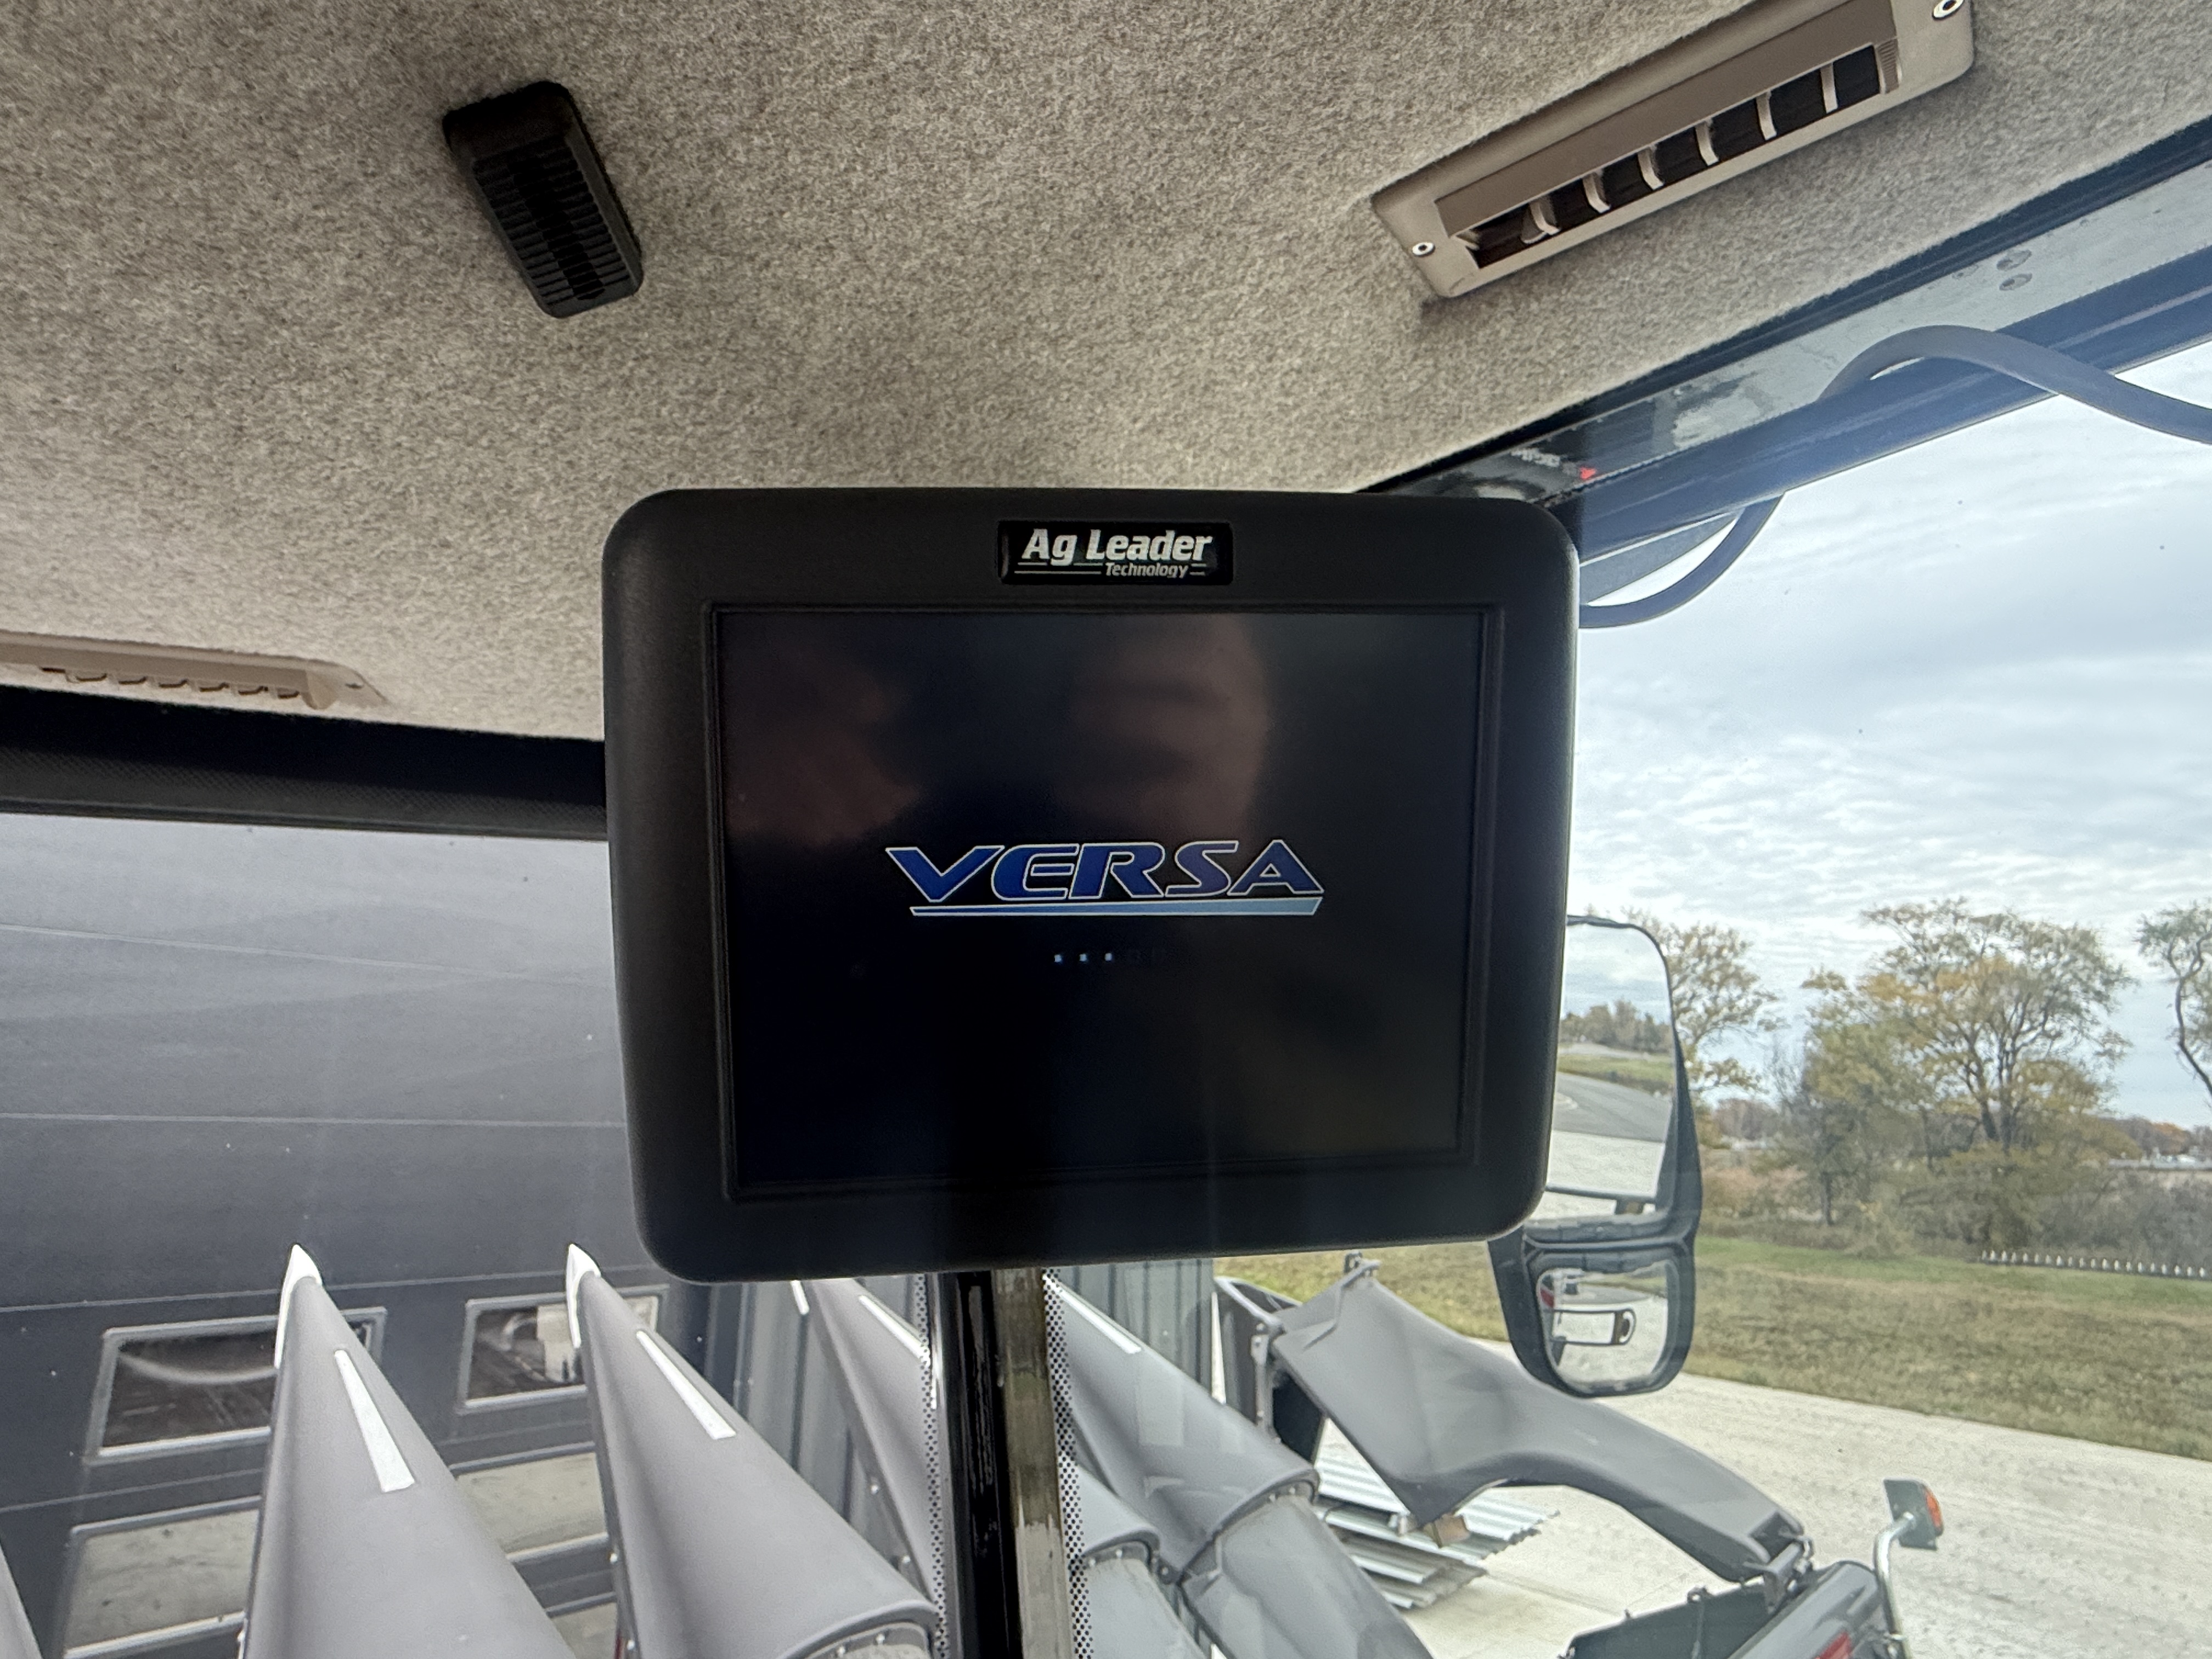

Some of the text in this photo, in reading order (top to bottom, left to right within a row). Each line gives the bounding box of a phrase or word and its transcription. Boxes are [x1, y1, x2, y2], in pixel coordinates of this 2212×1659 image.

[1022, 528, 1213, 566] Ag Leader
[1105, 562, 1189, 578] Technology
[885, 839, 1324, 902] VERSA
